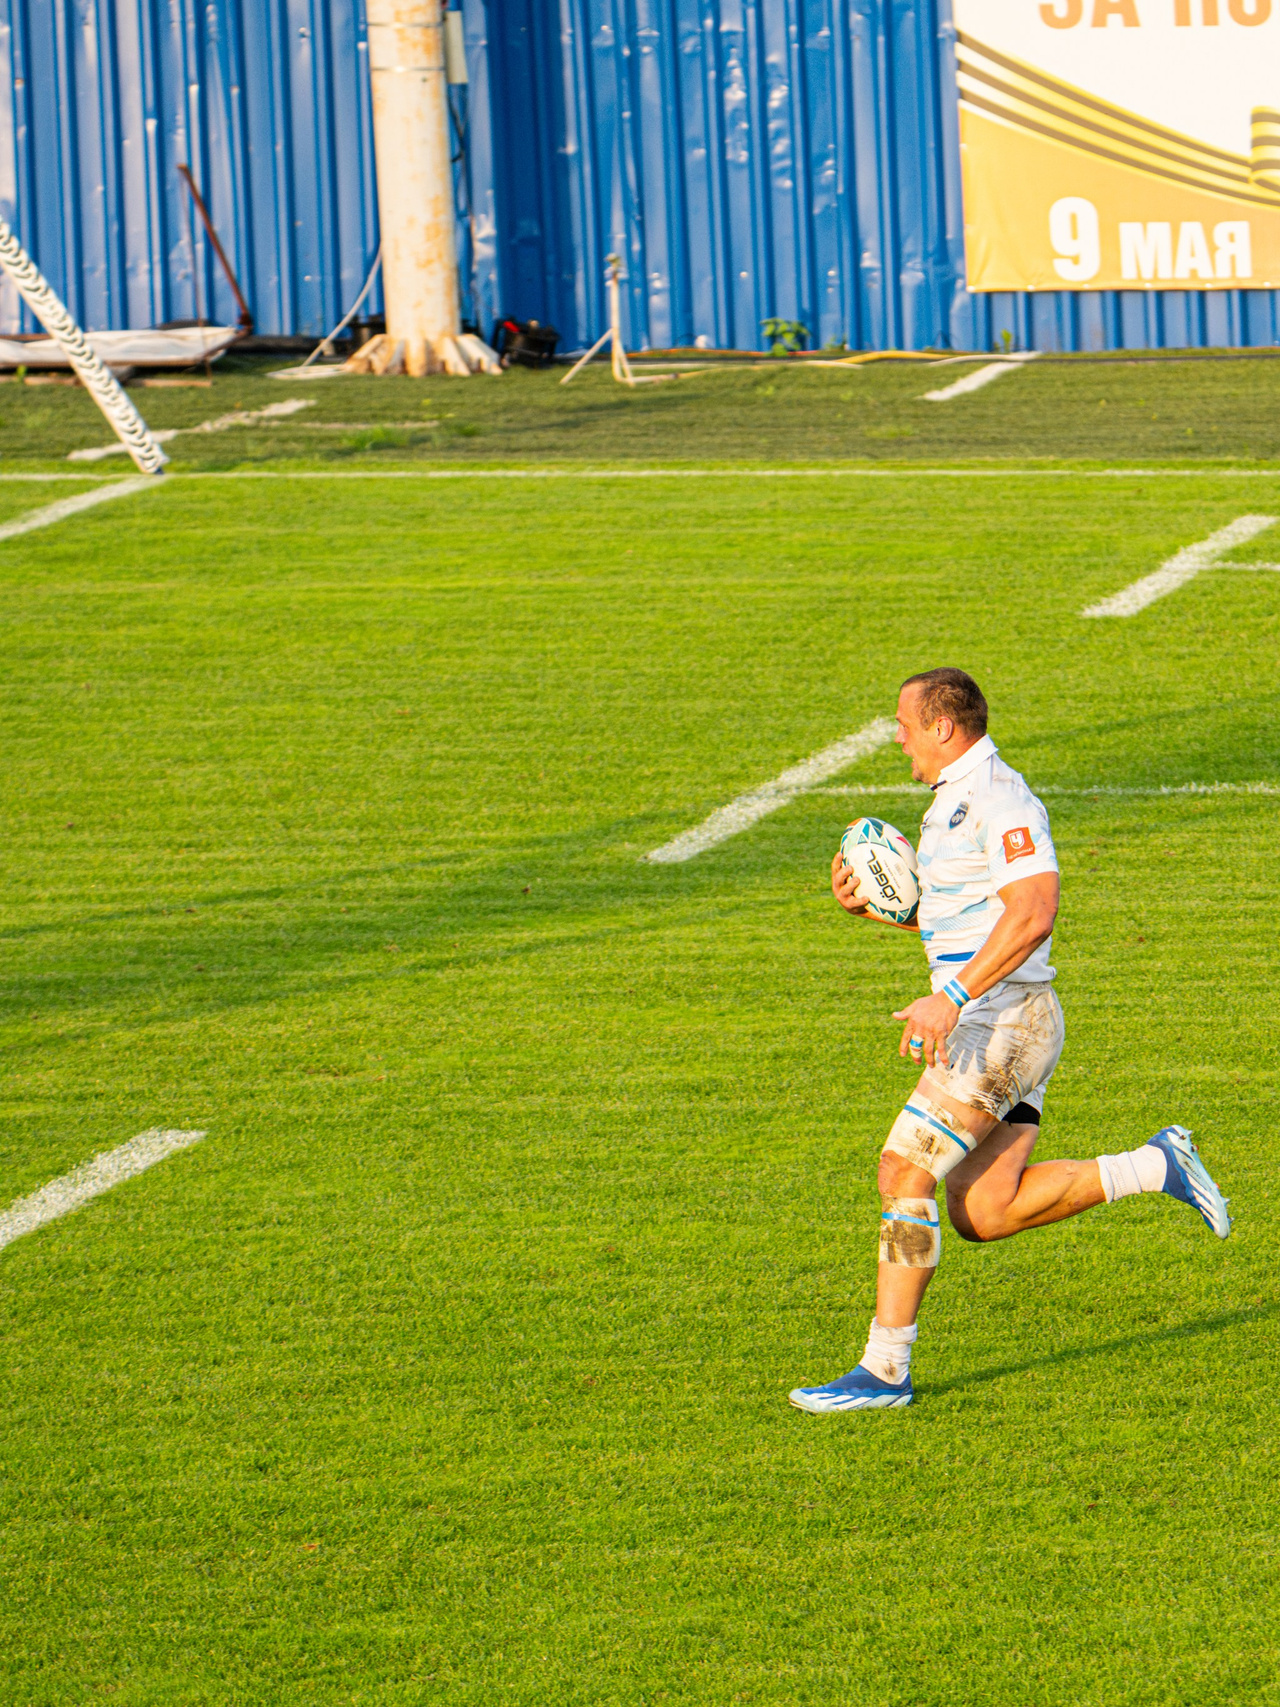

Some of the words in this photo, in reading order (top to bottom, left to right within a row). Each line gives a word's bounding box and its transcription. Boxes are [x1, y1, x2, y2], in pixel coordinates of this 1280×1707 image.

[1048, 196, 1101, 282] 9
[1118, 220, 1252, 280] МАЯ
[867, 849, 903, 904] JÖGEL
